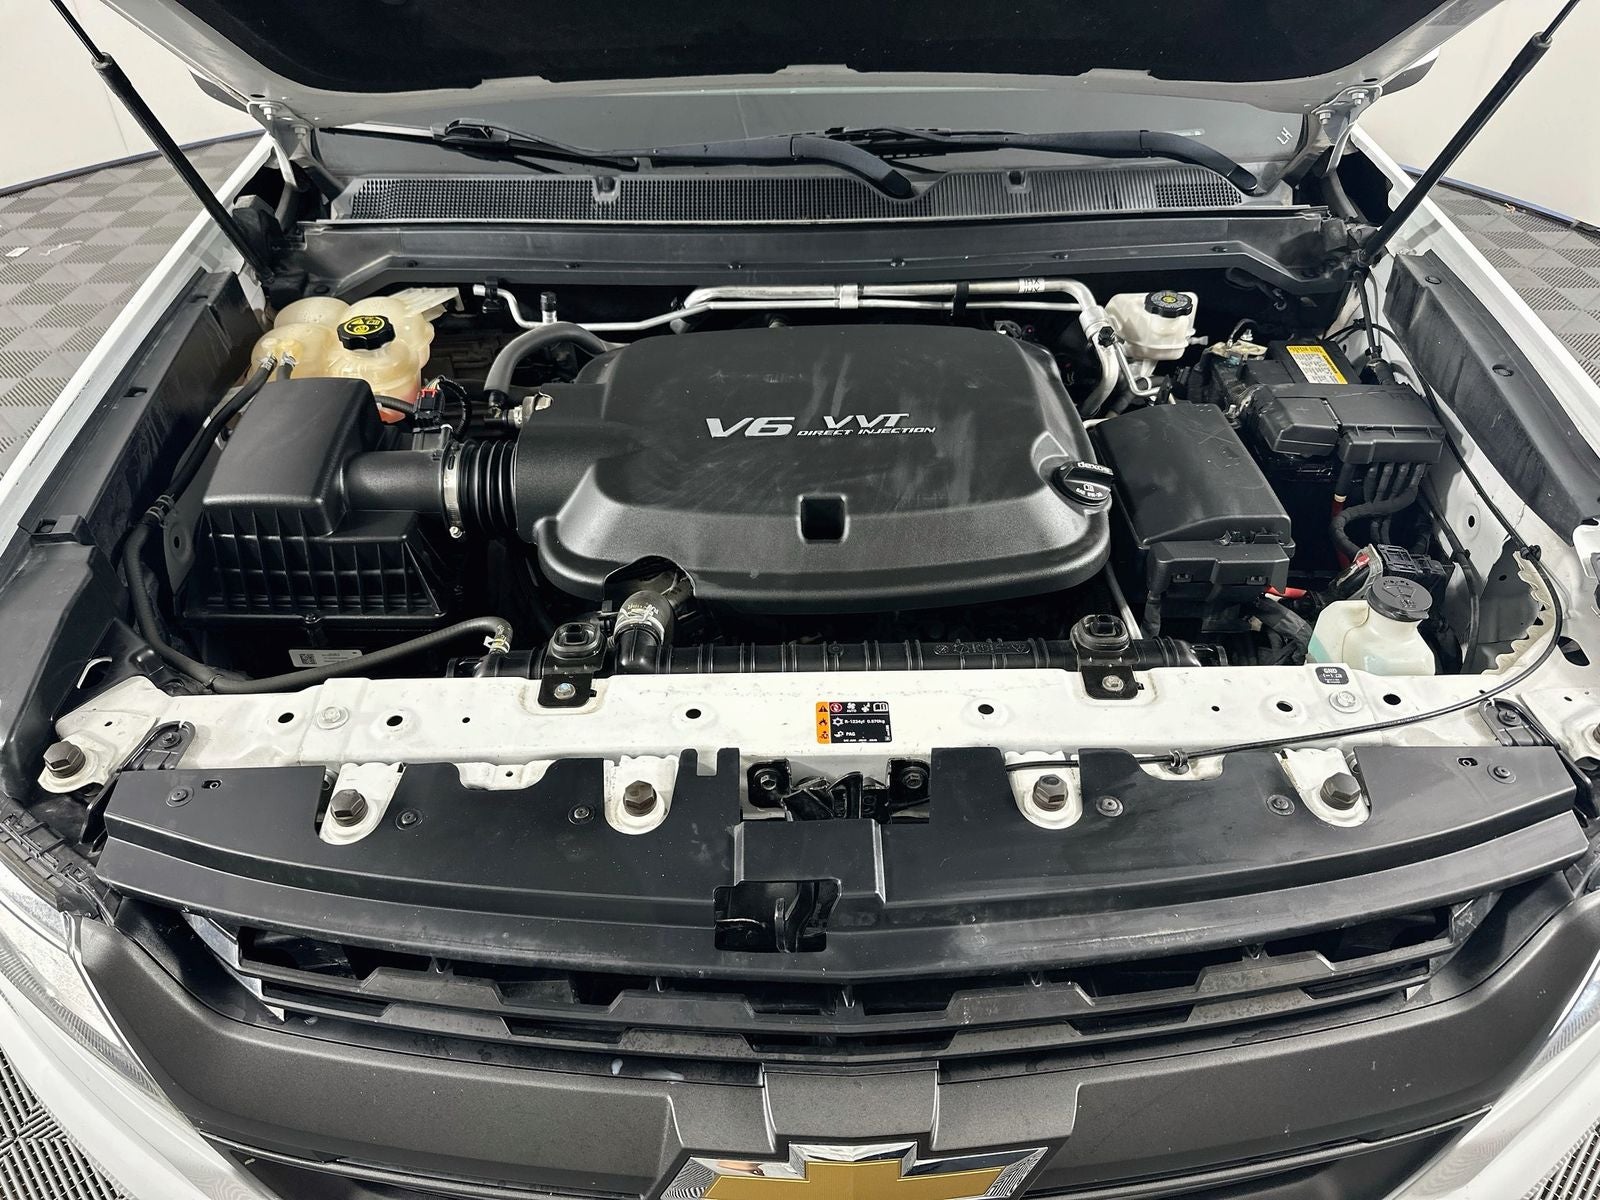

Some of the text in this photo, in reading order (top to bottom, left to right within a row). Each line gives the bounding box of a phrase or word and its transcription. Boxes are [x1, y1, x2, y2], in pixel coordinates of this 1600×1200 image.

[706, 413, 910, 438] V6 VVT
[797, 427, 936, 437] DIRECT INJECTION
